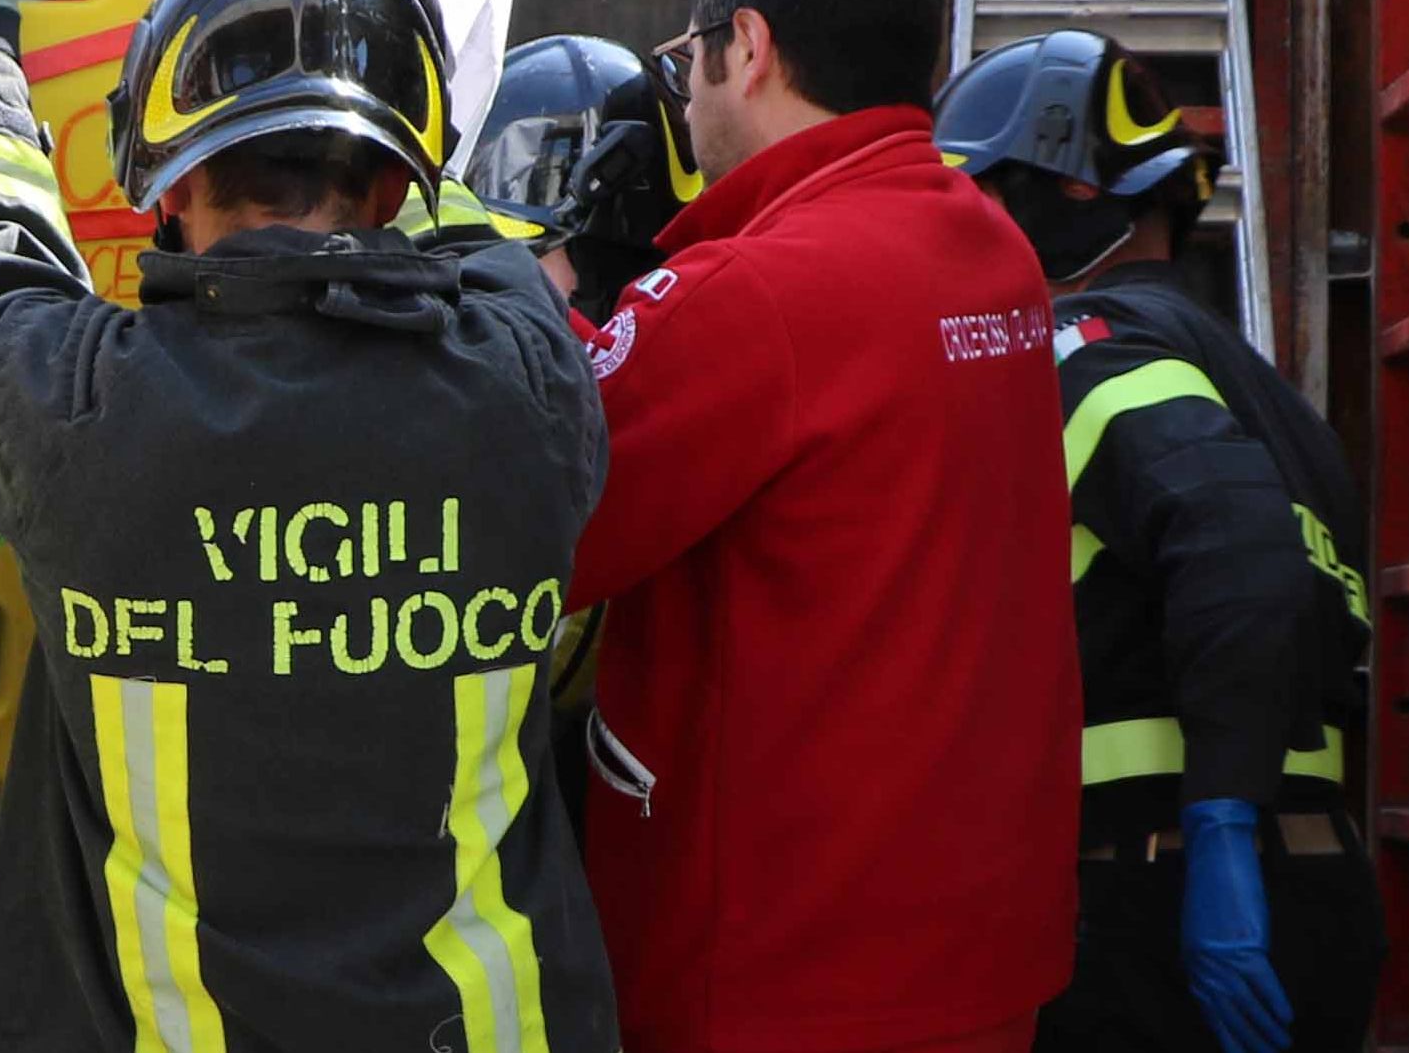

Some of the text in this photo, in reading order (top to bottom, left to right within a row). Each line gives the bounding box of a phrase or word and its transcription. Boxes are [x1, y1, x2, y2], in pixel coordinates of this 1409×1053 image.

[194, 497, 460, 582] VIGILI
[61, 578, 561, 675] DEL FUOCO
